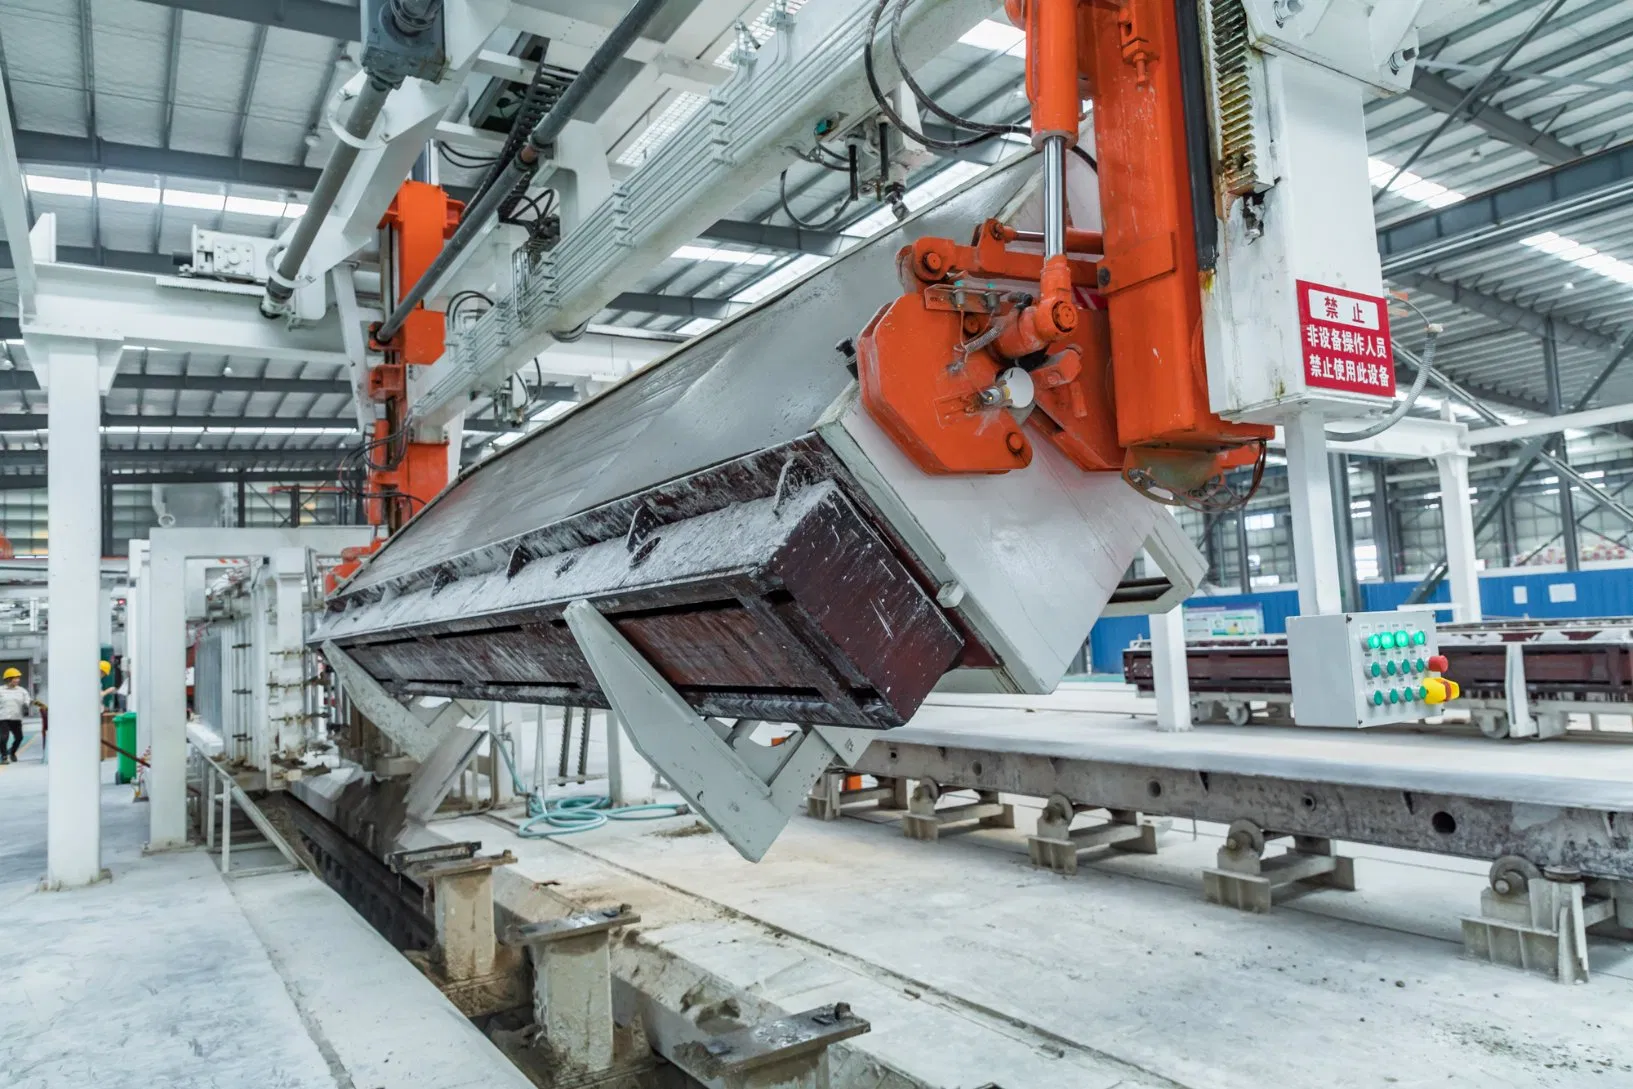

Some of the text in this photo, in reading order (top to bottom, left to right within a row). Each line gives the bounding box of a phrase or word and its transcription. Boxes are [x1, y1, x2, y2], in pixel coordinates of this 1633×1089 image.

[1324, 296, 1365, 324] 禁止
[1306, 324, 1387, 358] 非设备操作人员
[1309, 354, 1389, 387] 禁止使用此设备
